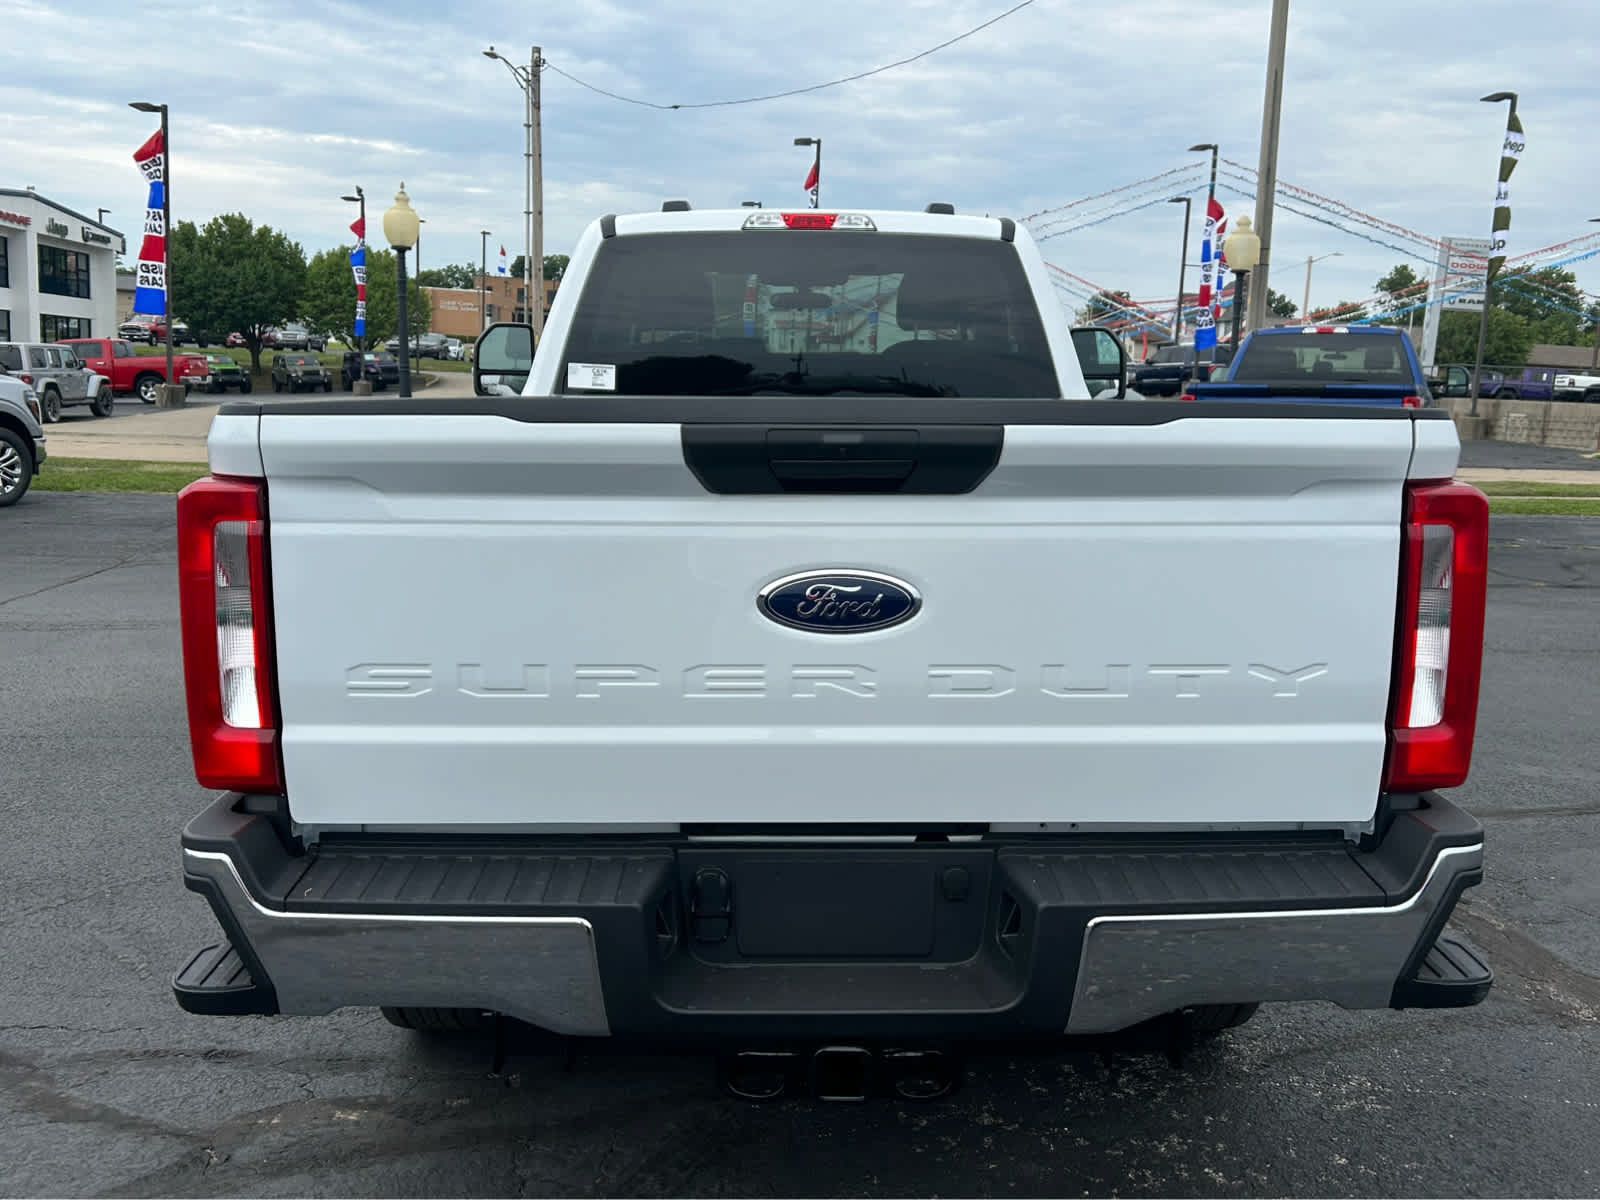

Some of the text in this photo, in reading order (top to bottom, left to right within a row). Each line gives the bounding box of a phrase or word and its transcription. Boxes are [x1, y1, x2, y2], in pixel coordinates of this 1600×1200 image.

[797, 583, 885, 618] Ford
[346, 662, 1329, 698] SUPER DUTY
